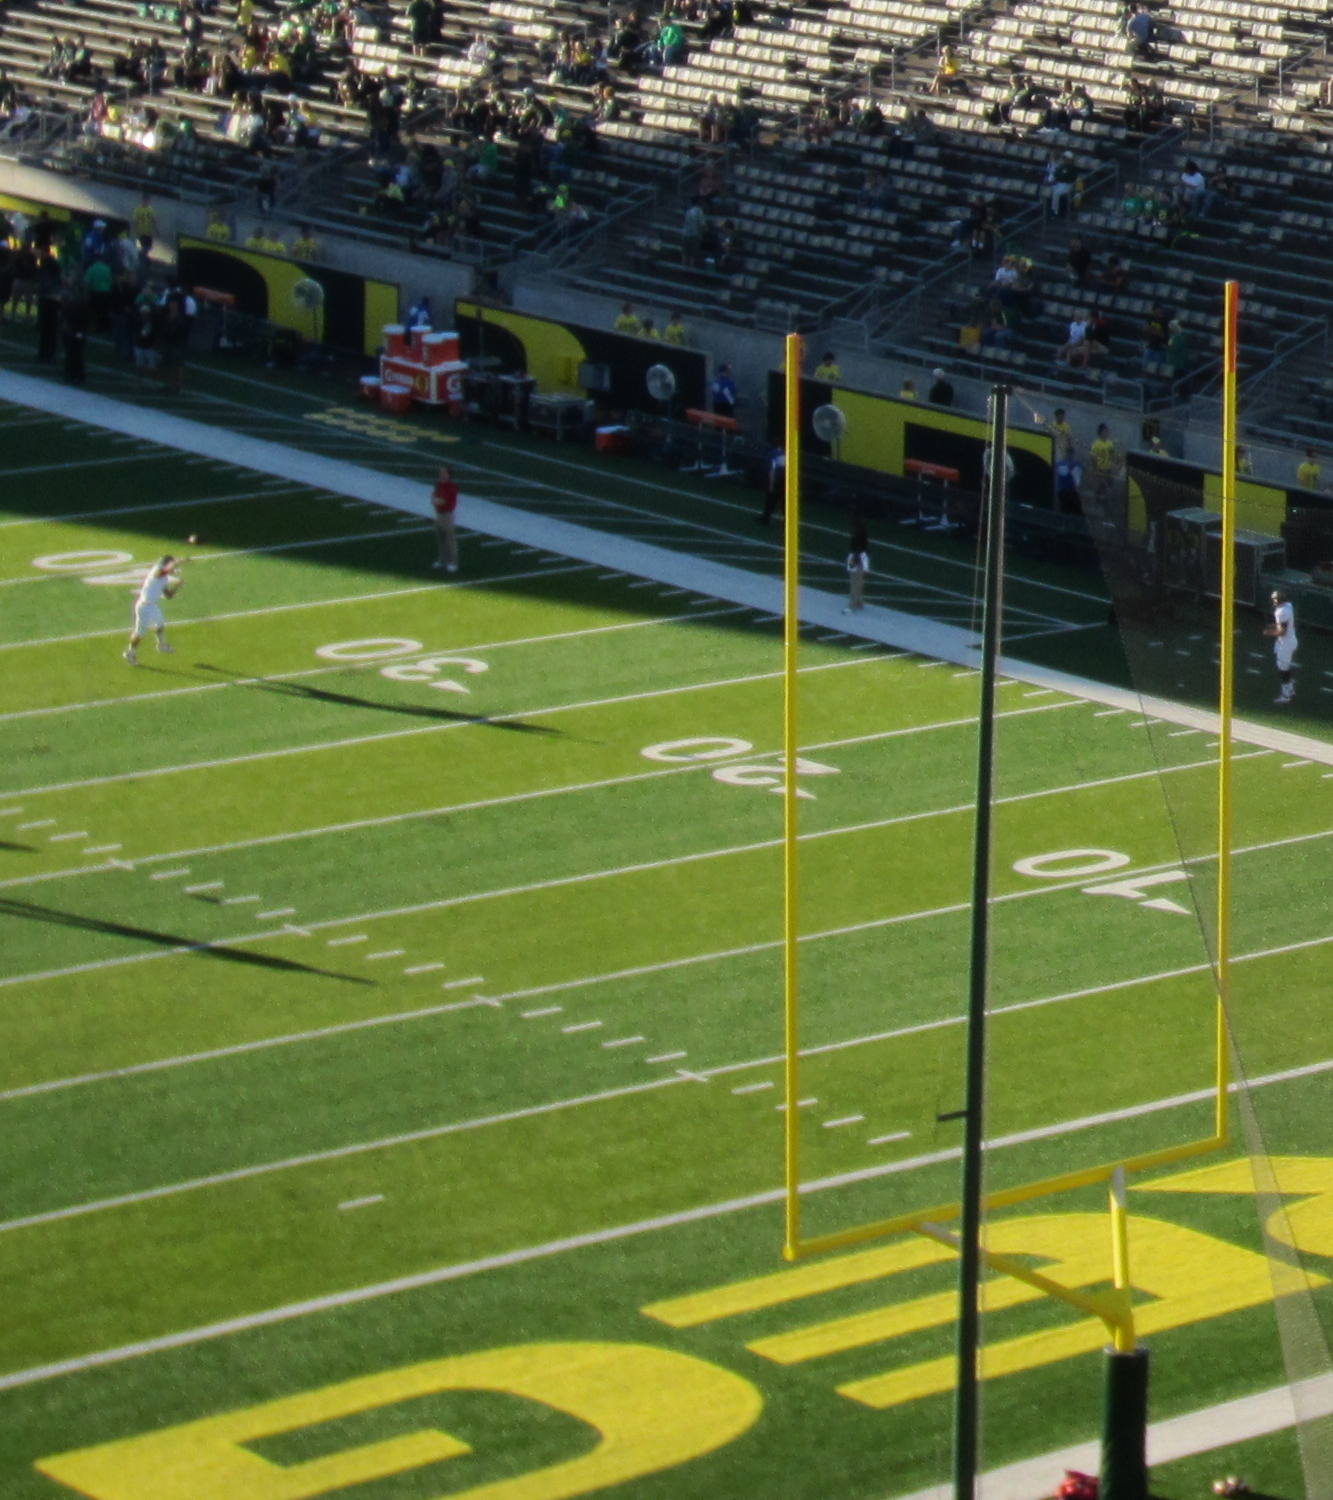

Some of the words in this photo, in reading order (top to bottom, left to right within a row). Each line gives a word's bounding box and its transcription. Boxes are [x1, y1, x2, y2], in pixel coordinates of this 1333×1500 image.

[315, 637, 489, 682] 30
[640, 736, 841, 787] 20
[1012, 847, 1194, 900] 10
